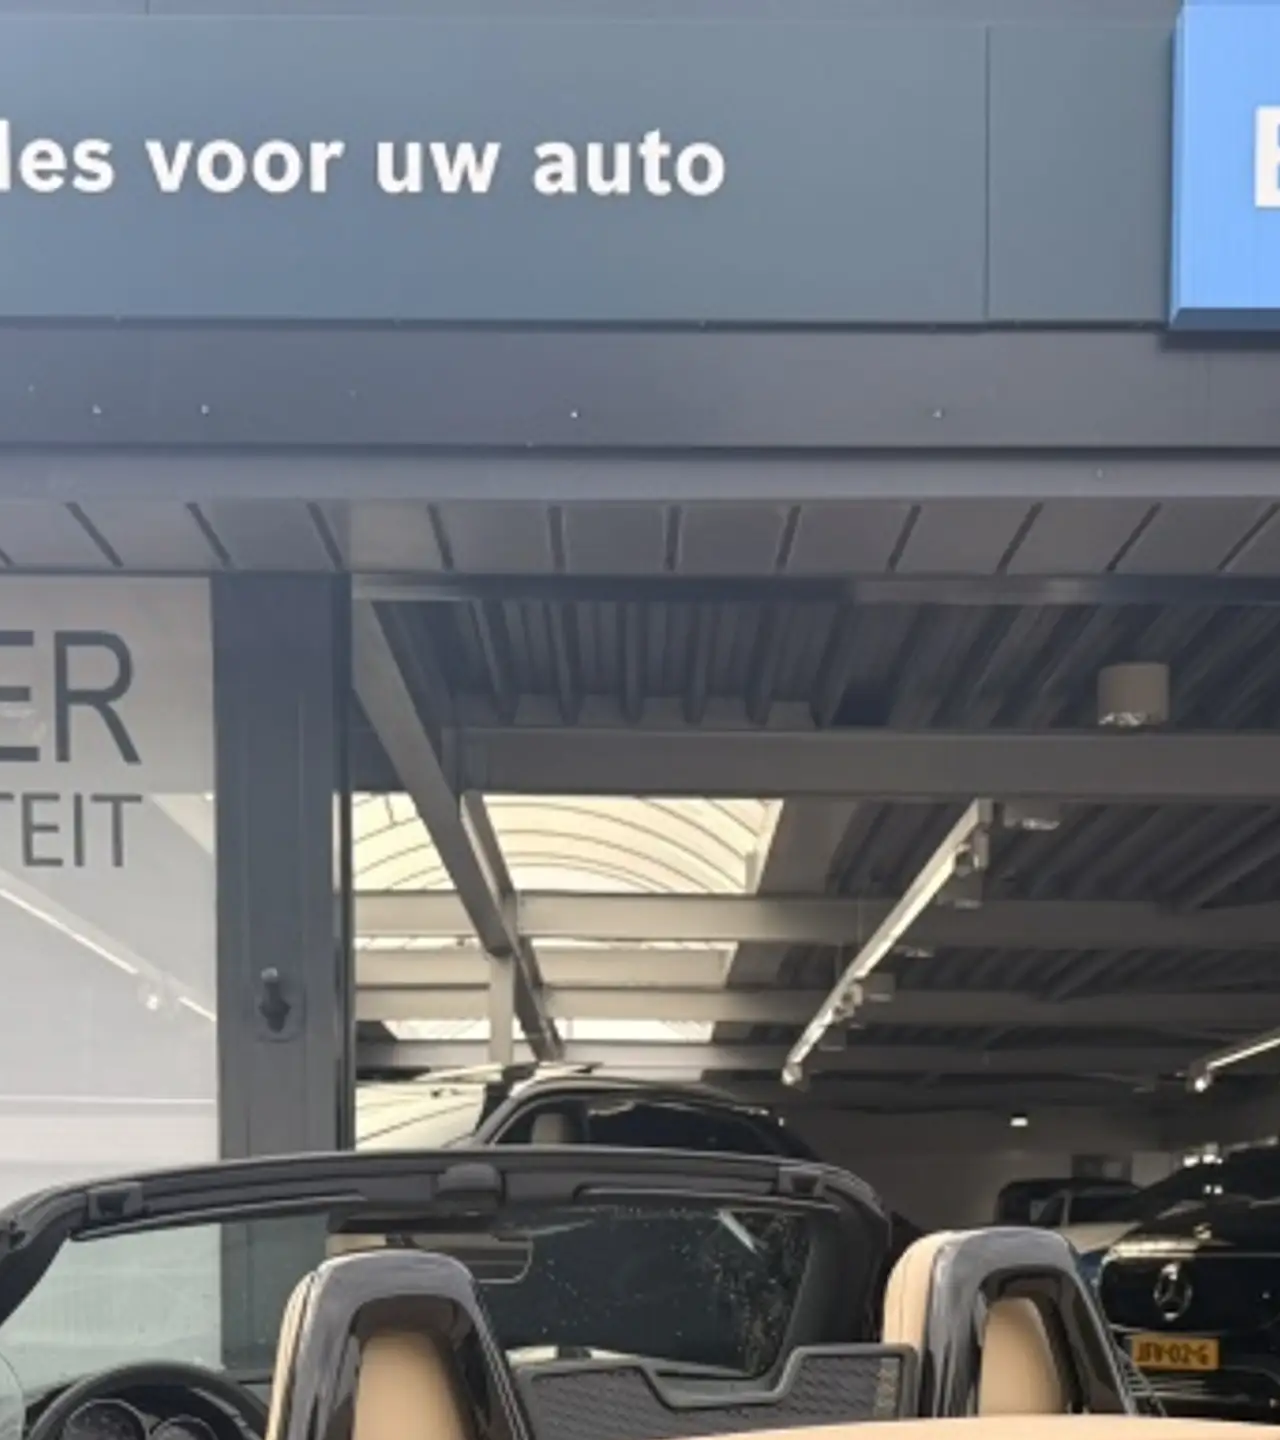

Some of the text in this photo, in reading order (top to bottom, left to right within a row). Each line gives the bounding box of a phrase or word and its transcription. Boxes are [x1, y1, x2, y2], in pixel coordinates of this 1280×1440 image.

[147, 139, 344, 196] voor
[375, 141, 502, 197] uw
[534, 130, 728, 199] auto
